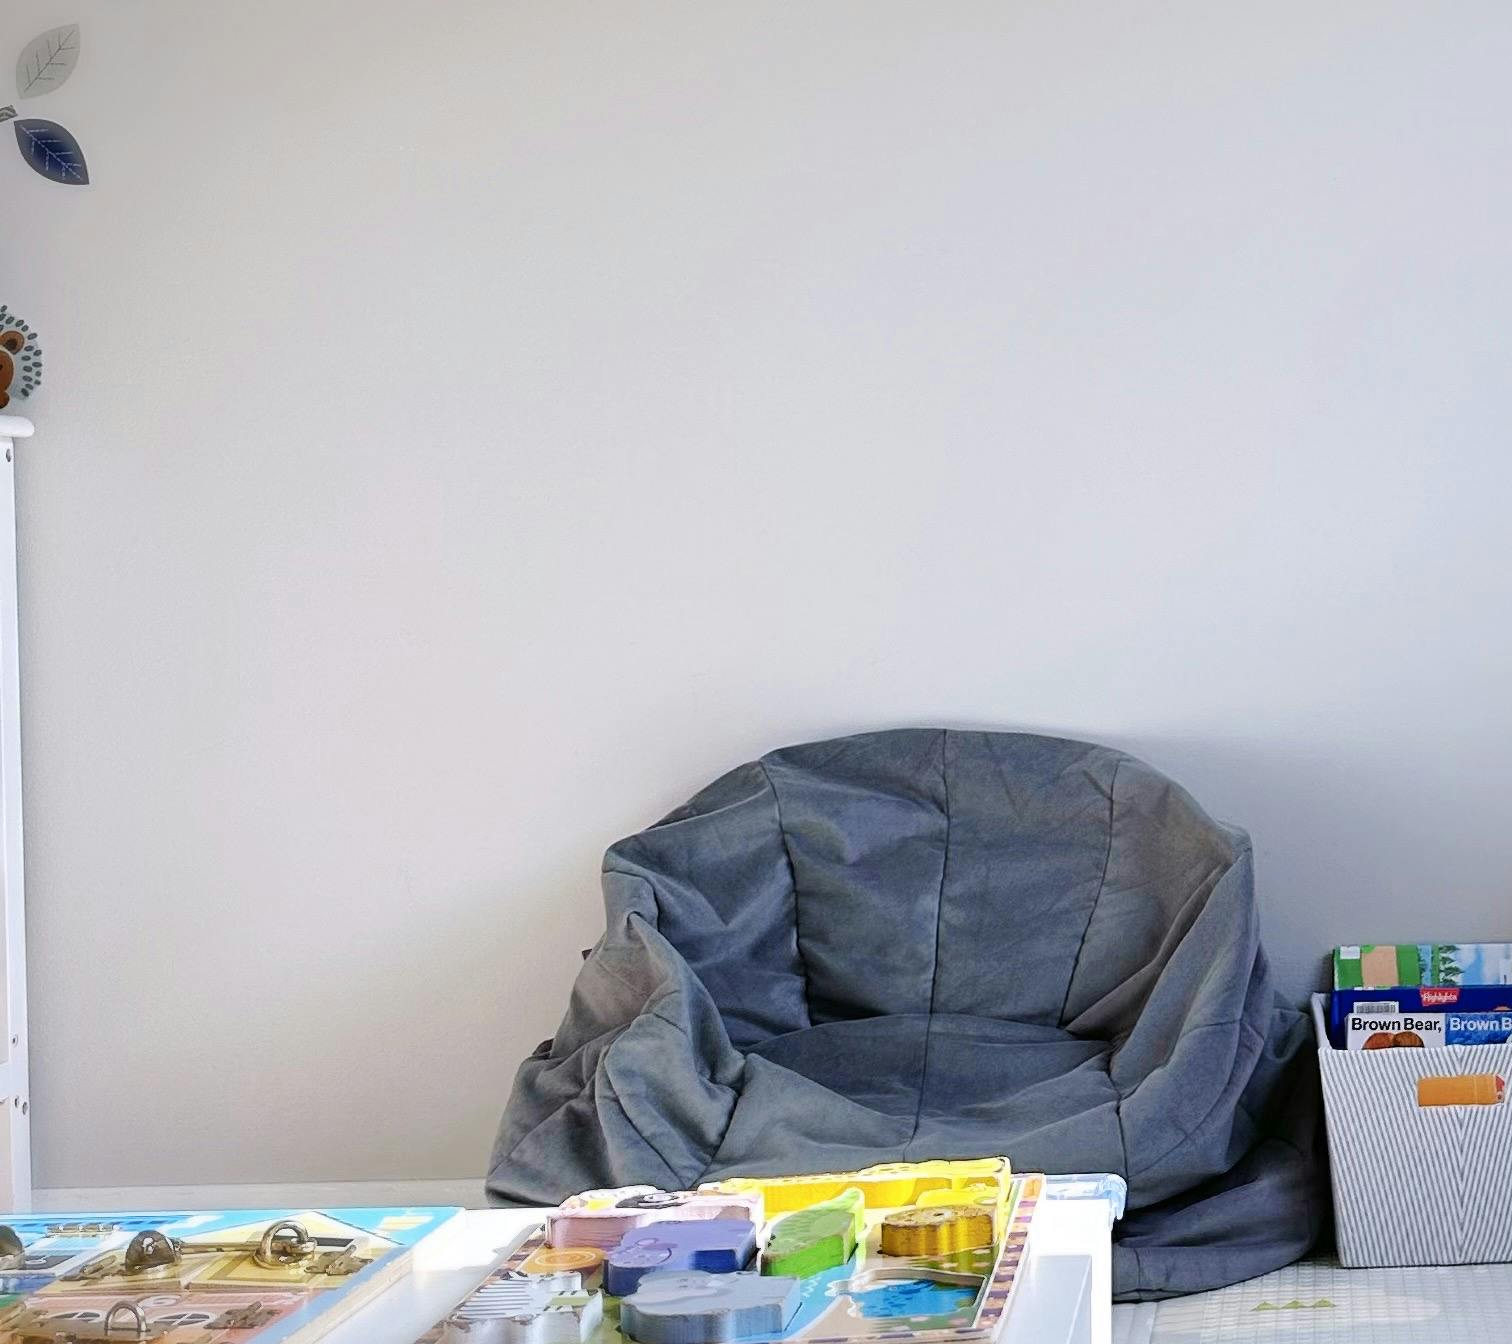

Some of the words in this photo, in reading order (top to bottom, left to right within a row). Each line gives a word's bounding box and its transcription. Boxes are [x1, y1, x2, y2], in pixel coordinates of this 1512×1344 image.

[1351, 1017, 1400, 1031] Brown
[1404, 1017, 1442, 1033] Bear,
[1450, 1017, 1500, 1031] Brown
